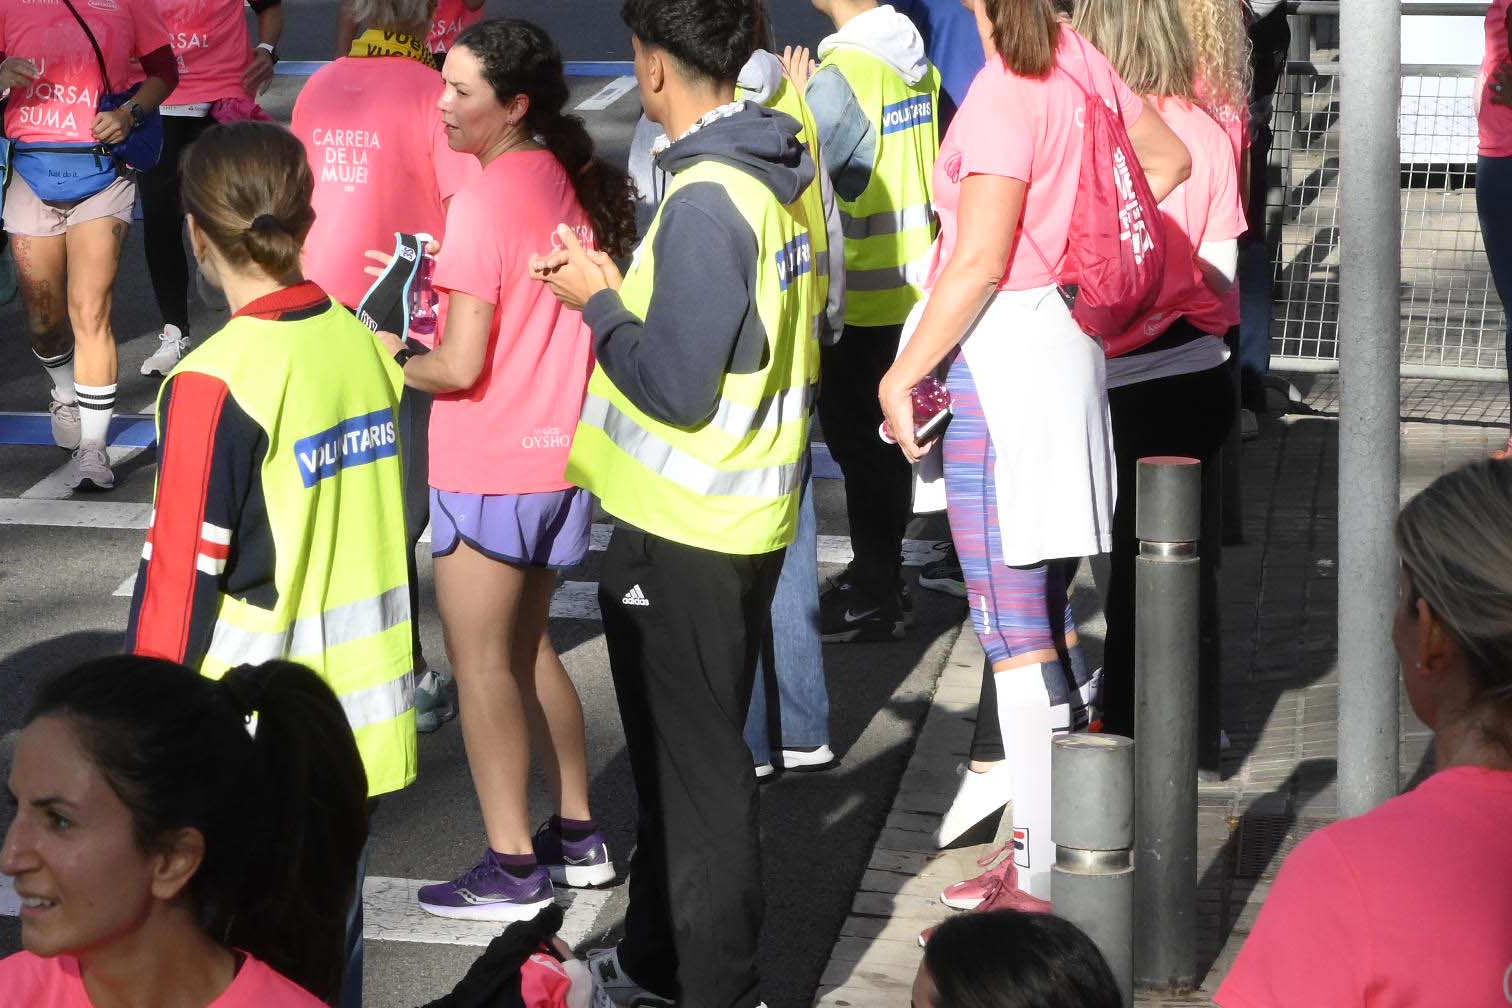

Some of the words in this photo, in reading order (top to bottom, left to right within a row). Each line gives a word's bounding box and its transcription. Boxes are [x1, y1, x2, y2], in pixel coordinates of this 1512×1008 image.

[20, 106, 77, 130] SUMA
[312, 128, 381, 149] CARRERA
[325, 147, 347, 164] DE
[352, 148, 369, 165] LA
[521, 433, 570, 449] OYSHO
[622, 596, 649, 607] adidas
